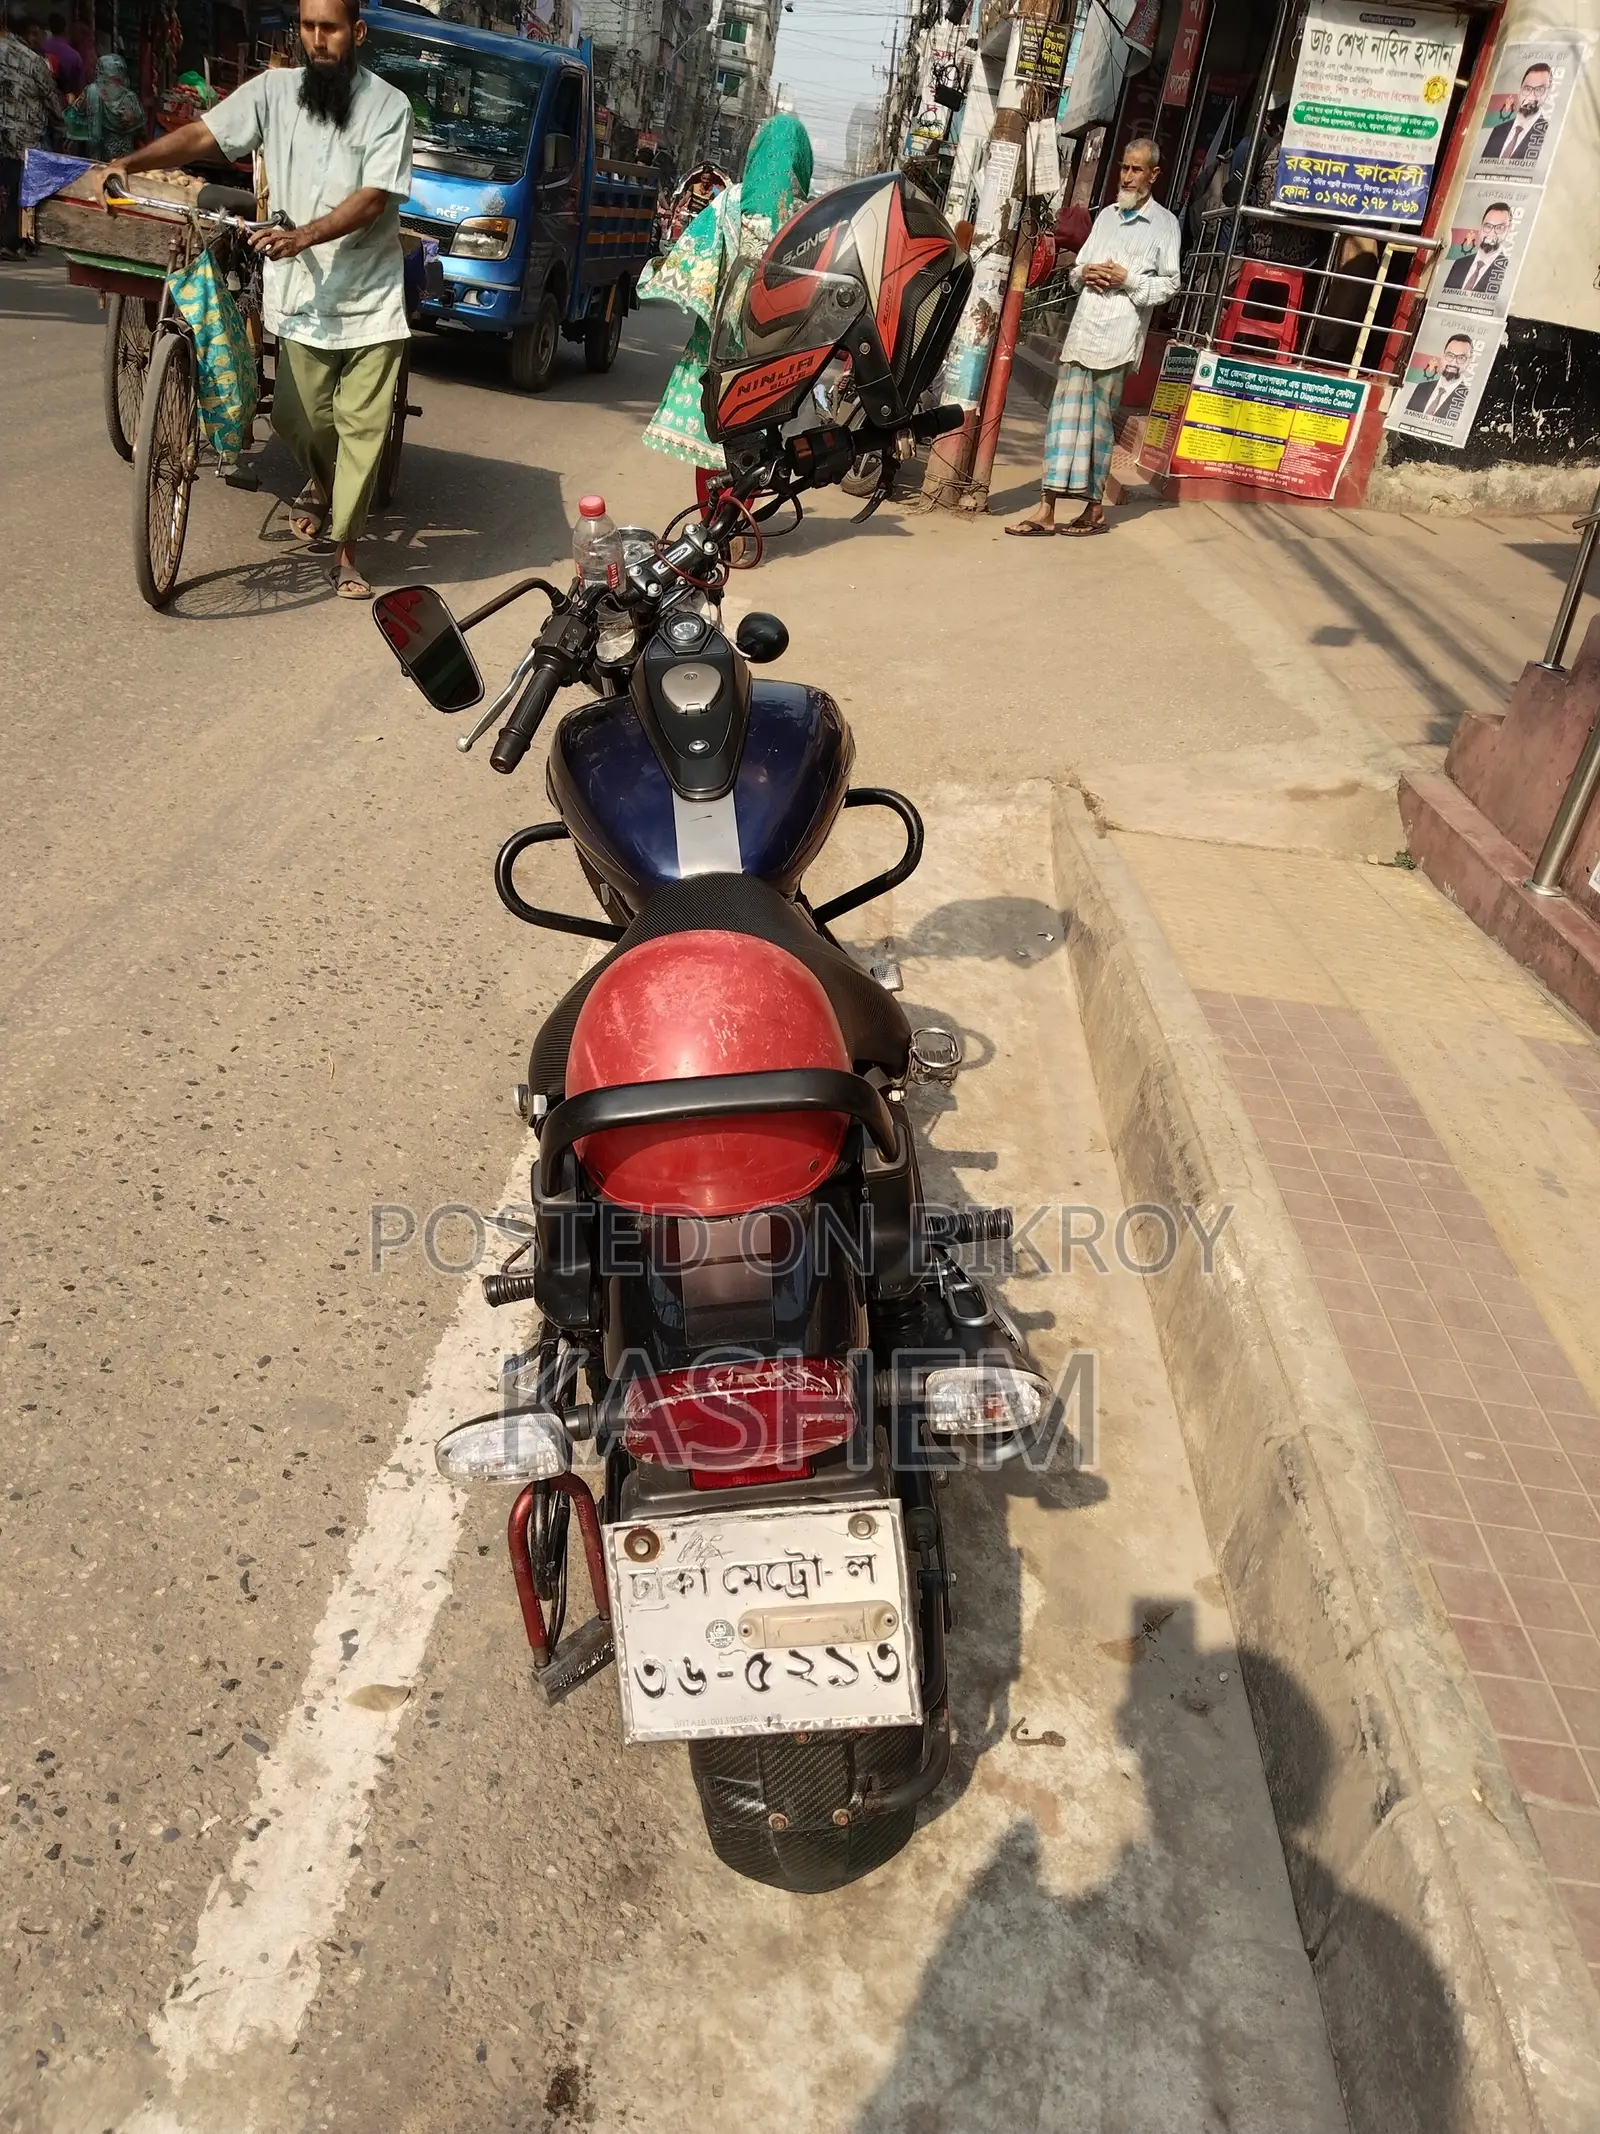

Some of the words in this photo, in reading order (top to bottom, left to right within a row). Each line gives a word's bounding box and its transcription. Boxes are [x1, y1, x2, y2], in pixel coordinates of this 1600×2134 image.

[1043, 37, 1064, 52] টিচার
[1311, 29, 1333, 56] ডাঃ
[1337, 32, 1368, 59] শেখ
[1371, 29, 1411, 67] নাহিদ
[1414, 39, 1456, 70] হাসান
[1041, 50, 1062, 66] দিচ্ছি
[1285, 155, 1350, 178] রহমান
[1354, 163, 1427, 187] ফার্মেসী
[1508, 160, 1536, 168] HOQUE
[1315, 190, 1358, 207] ০১৭২৫
[1361, 195, 1388, 210] ২৭৮
[1392, 199, 1419, 213] ৮৬৯
[1477, 190, 1513, 200] CAPTAIN
[1516, 194, 1529, 202] OF
[436, 207, 458, 219] ACE
[782, 226, 831, 265] S.ONE
[1441, 288, 1468, 297] AMINUL
[1471, 292, 1498, 301] HOQUE
[1441, 320, 1474, 333] CAPTAIN
[736, 355, 814, 397] NINJA
[770, 371, 807, 391] ELITE
[1216, 376, 1244, 389] Shwapno
[1244, 381, 1268, 392] General
[1268, 386, 1293, 397] Hospital
[1294, 391, 1299, 399] &
[1300, 392, 1332, 405] Diagnostic
[1333, 398, 1354, 408] Center
[1404, 410, 1429, 421] AMINUL
[1431, 417, 1457, 427] HOQUE
[627, 1563, 711, 1600] ঢাকা
